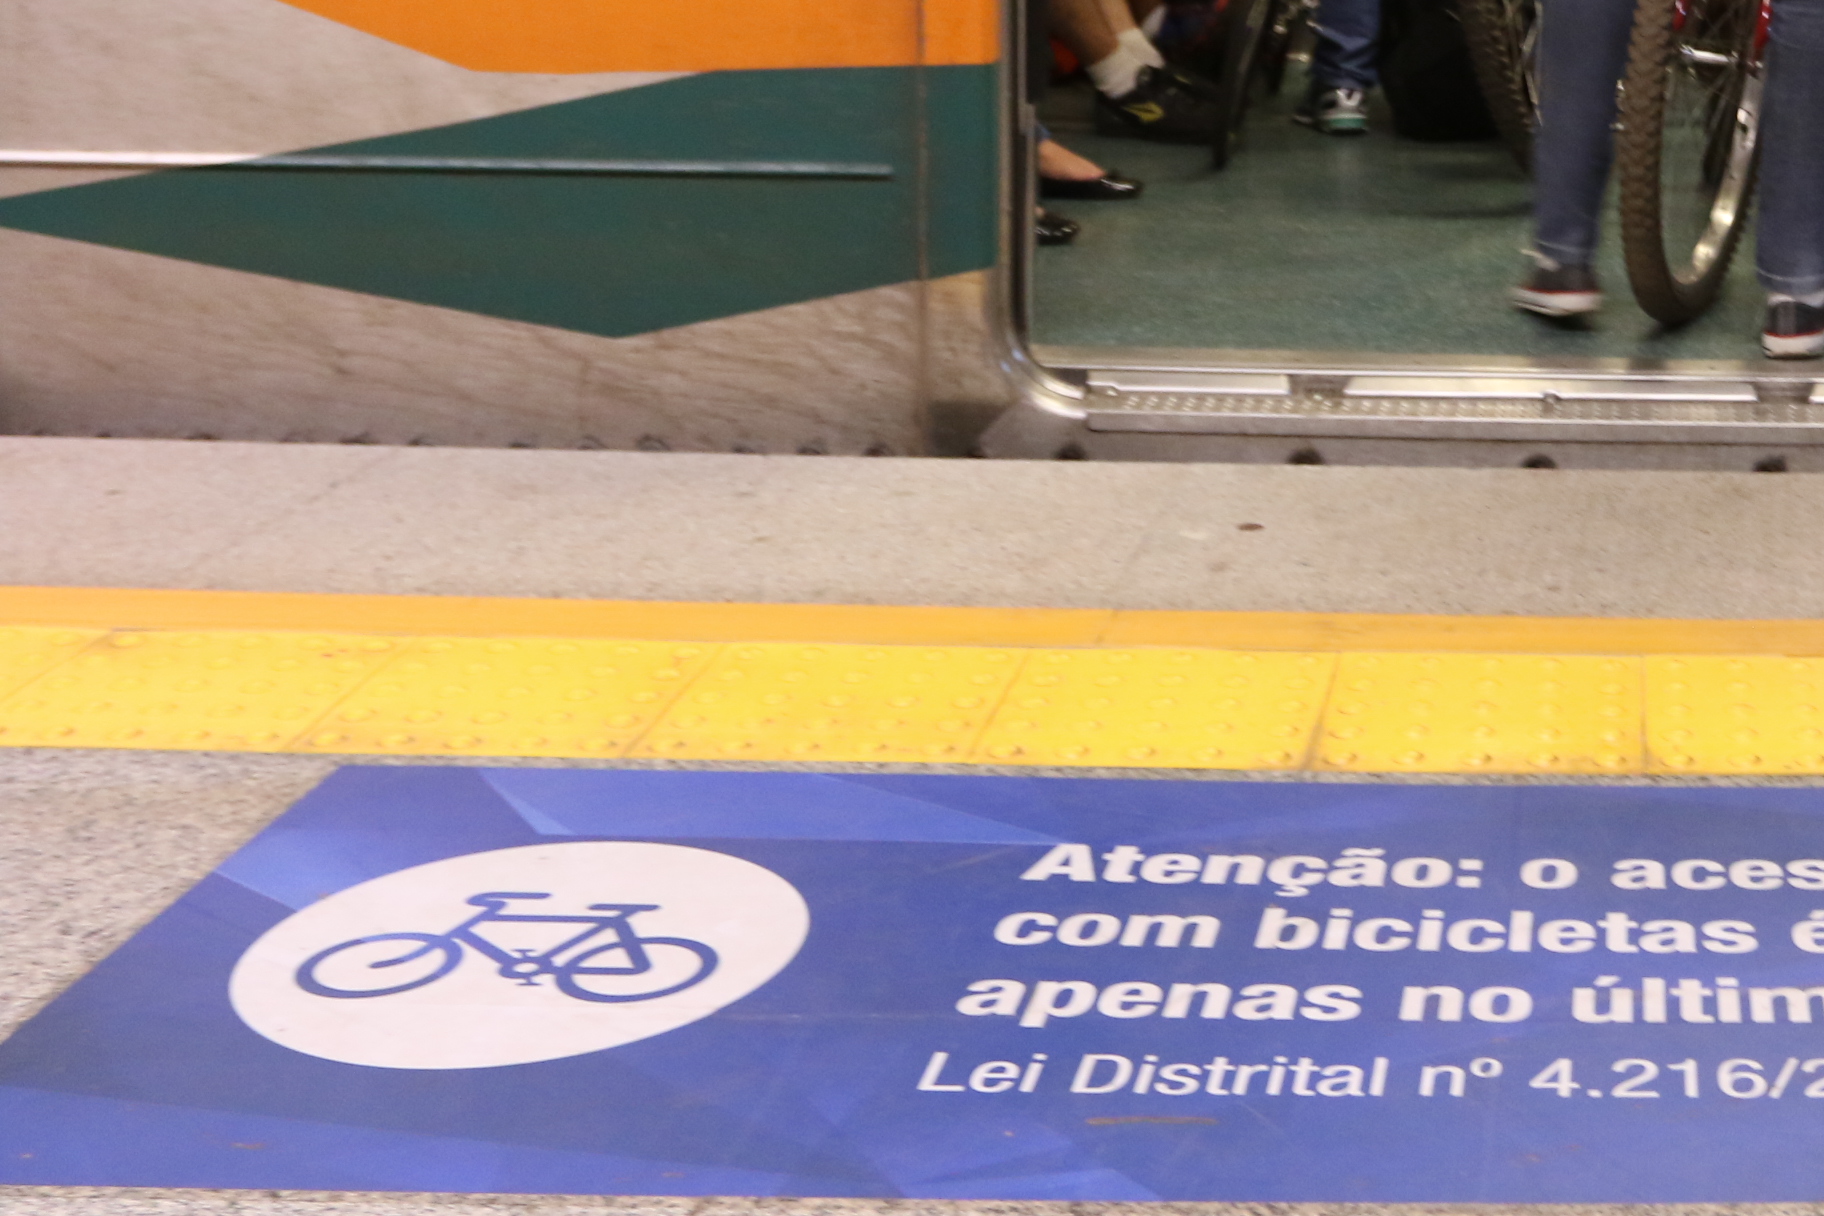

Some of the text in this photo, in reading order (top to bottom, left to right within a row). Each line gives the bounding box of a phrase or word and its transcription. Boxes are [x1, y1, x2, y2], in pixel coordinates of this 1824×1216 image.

[1020, 842, 1484, 898] Atenção:
[1519, 857, 1579, 890] o
[993, 911, 1221, 949] com
[1253, 905, 1760, 955] bicicletas
[955, 978, 1363, 1028] apenas
[1398, 985, 1534, 1024] no
[916, 1051, 1048, 1093] Lei
[1069, 1053, 1390, 1098] Distrital
